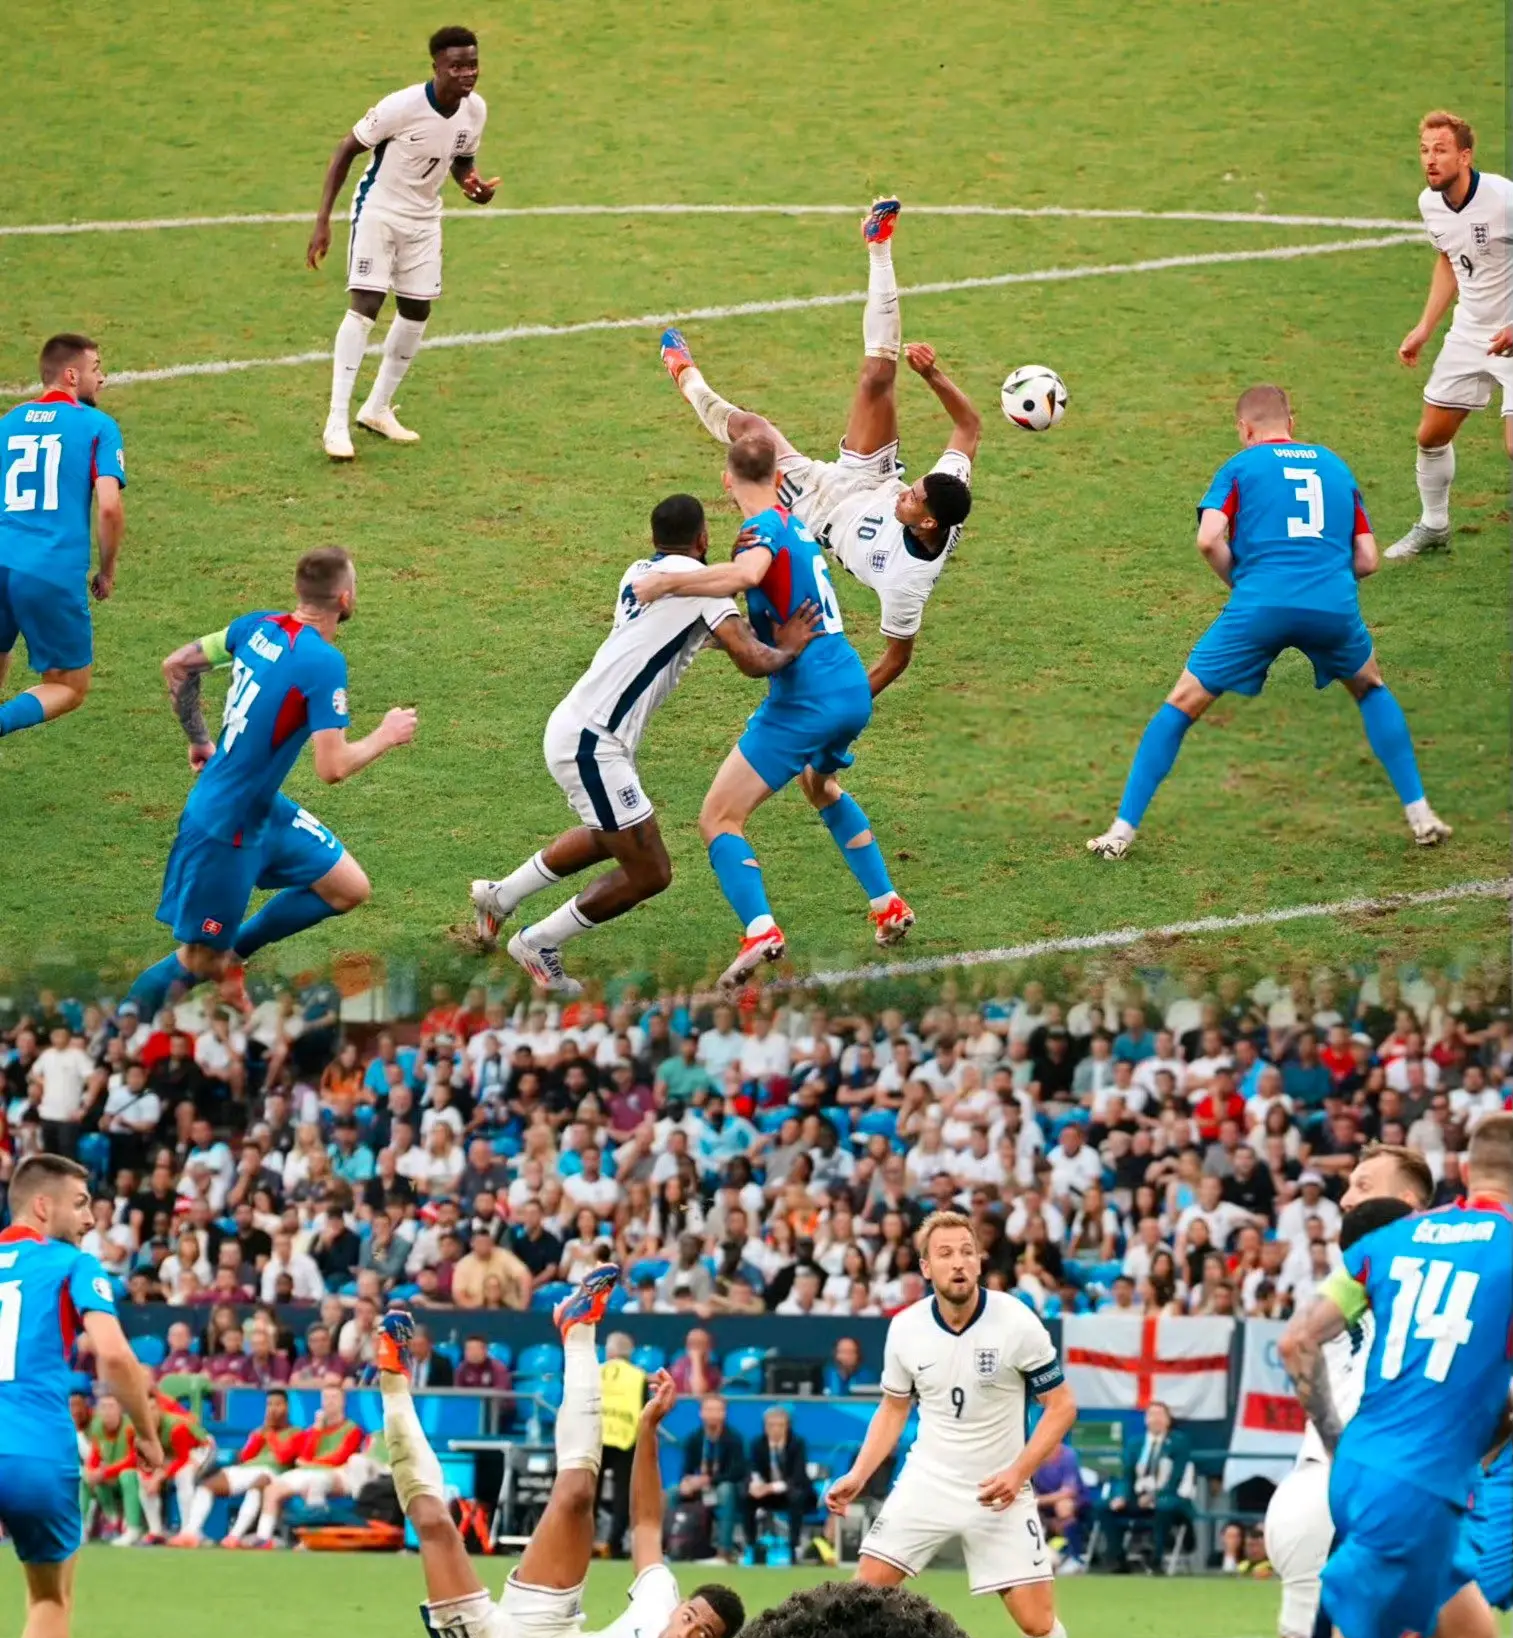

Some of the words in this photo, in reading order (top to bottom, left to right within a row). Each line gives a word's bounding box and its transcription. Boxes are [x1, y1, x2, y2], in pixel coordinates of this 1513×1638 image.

[422, 157, 440, 179] 7
[1460, 253, 1474, 278] 9
[4, 433, 63, 512] 21
[1283, 466, 1325, 539] 3
[857, 515, 884, 541] 10
[1379, 1256, 1481, 1383] 14
[951, 1386, 966, 1419] 9
[1026, 1518, 1041, 1551] 9
